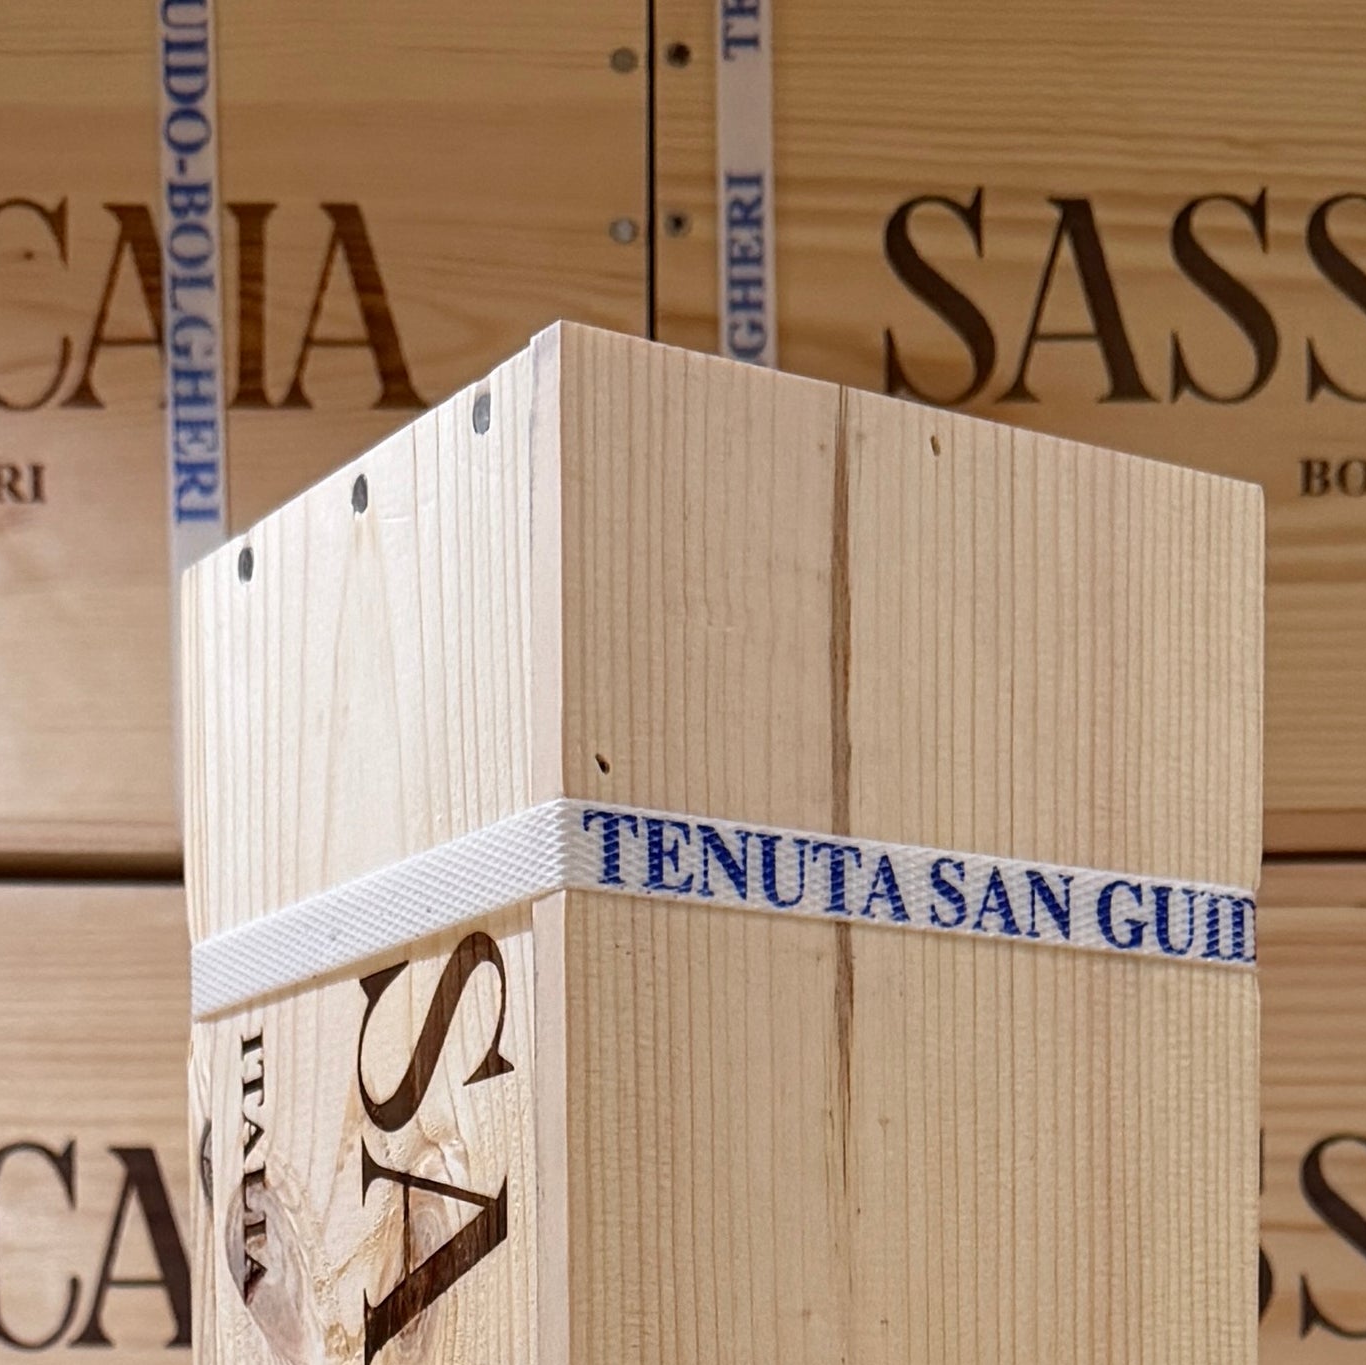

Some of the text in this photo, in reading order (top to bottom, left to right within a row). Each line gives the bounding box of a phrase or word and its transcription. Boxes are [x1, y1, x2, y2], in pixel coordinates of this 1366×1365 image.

[583, 810, 911, 922] TENUTA
[929, 858, 1075, 940] SAN
[241, 1029, 268, 1303] ITALIA
